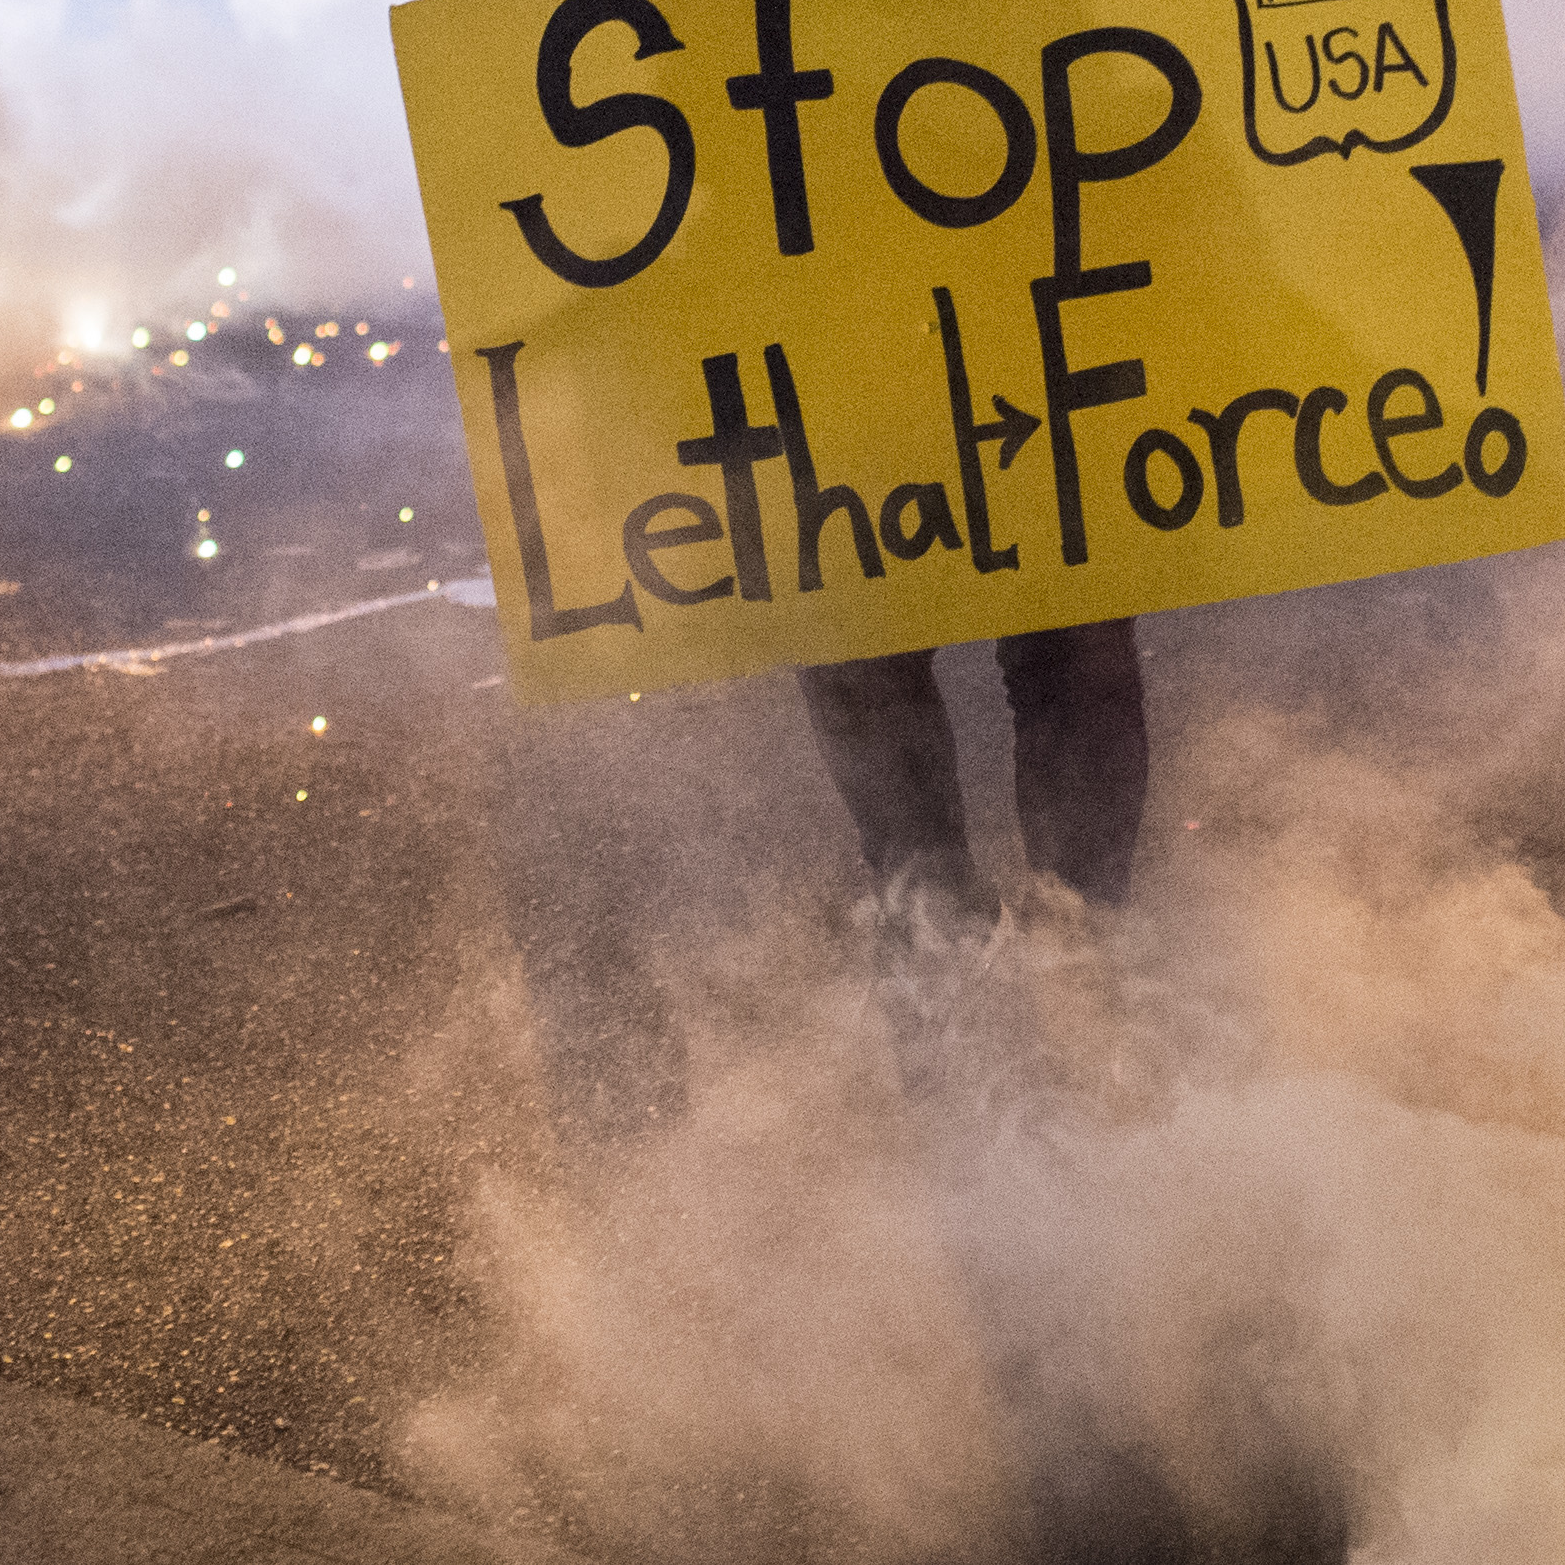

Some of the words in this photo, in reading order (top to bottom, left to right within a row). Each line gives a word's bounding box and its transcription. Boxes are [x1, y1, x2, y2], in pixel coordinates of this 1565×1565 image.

[1264, 22, 1430, 114] USA
[474, 286, 1020, 642] Lethal
[1031, 159, 1528, 567] Force!
